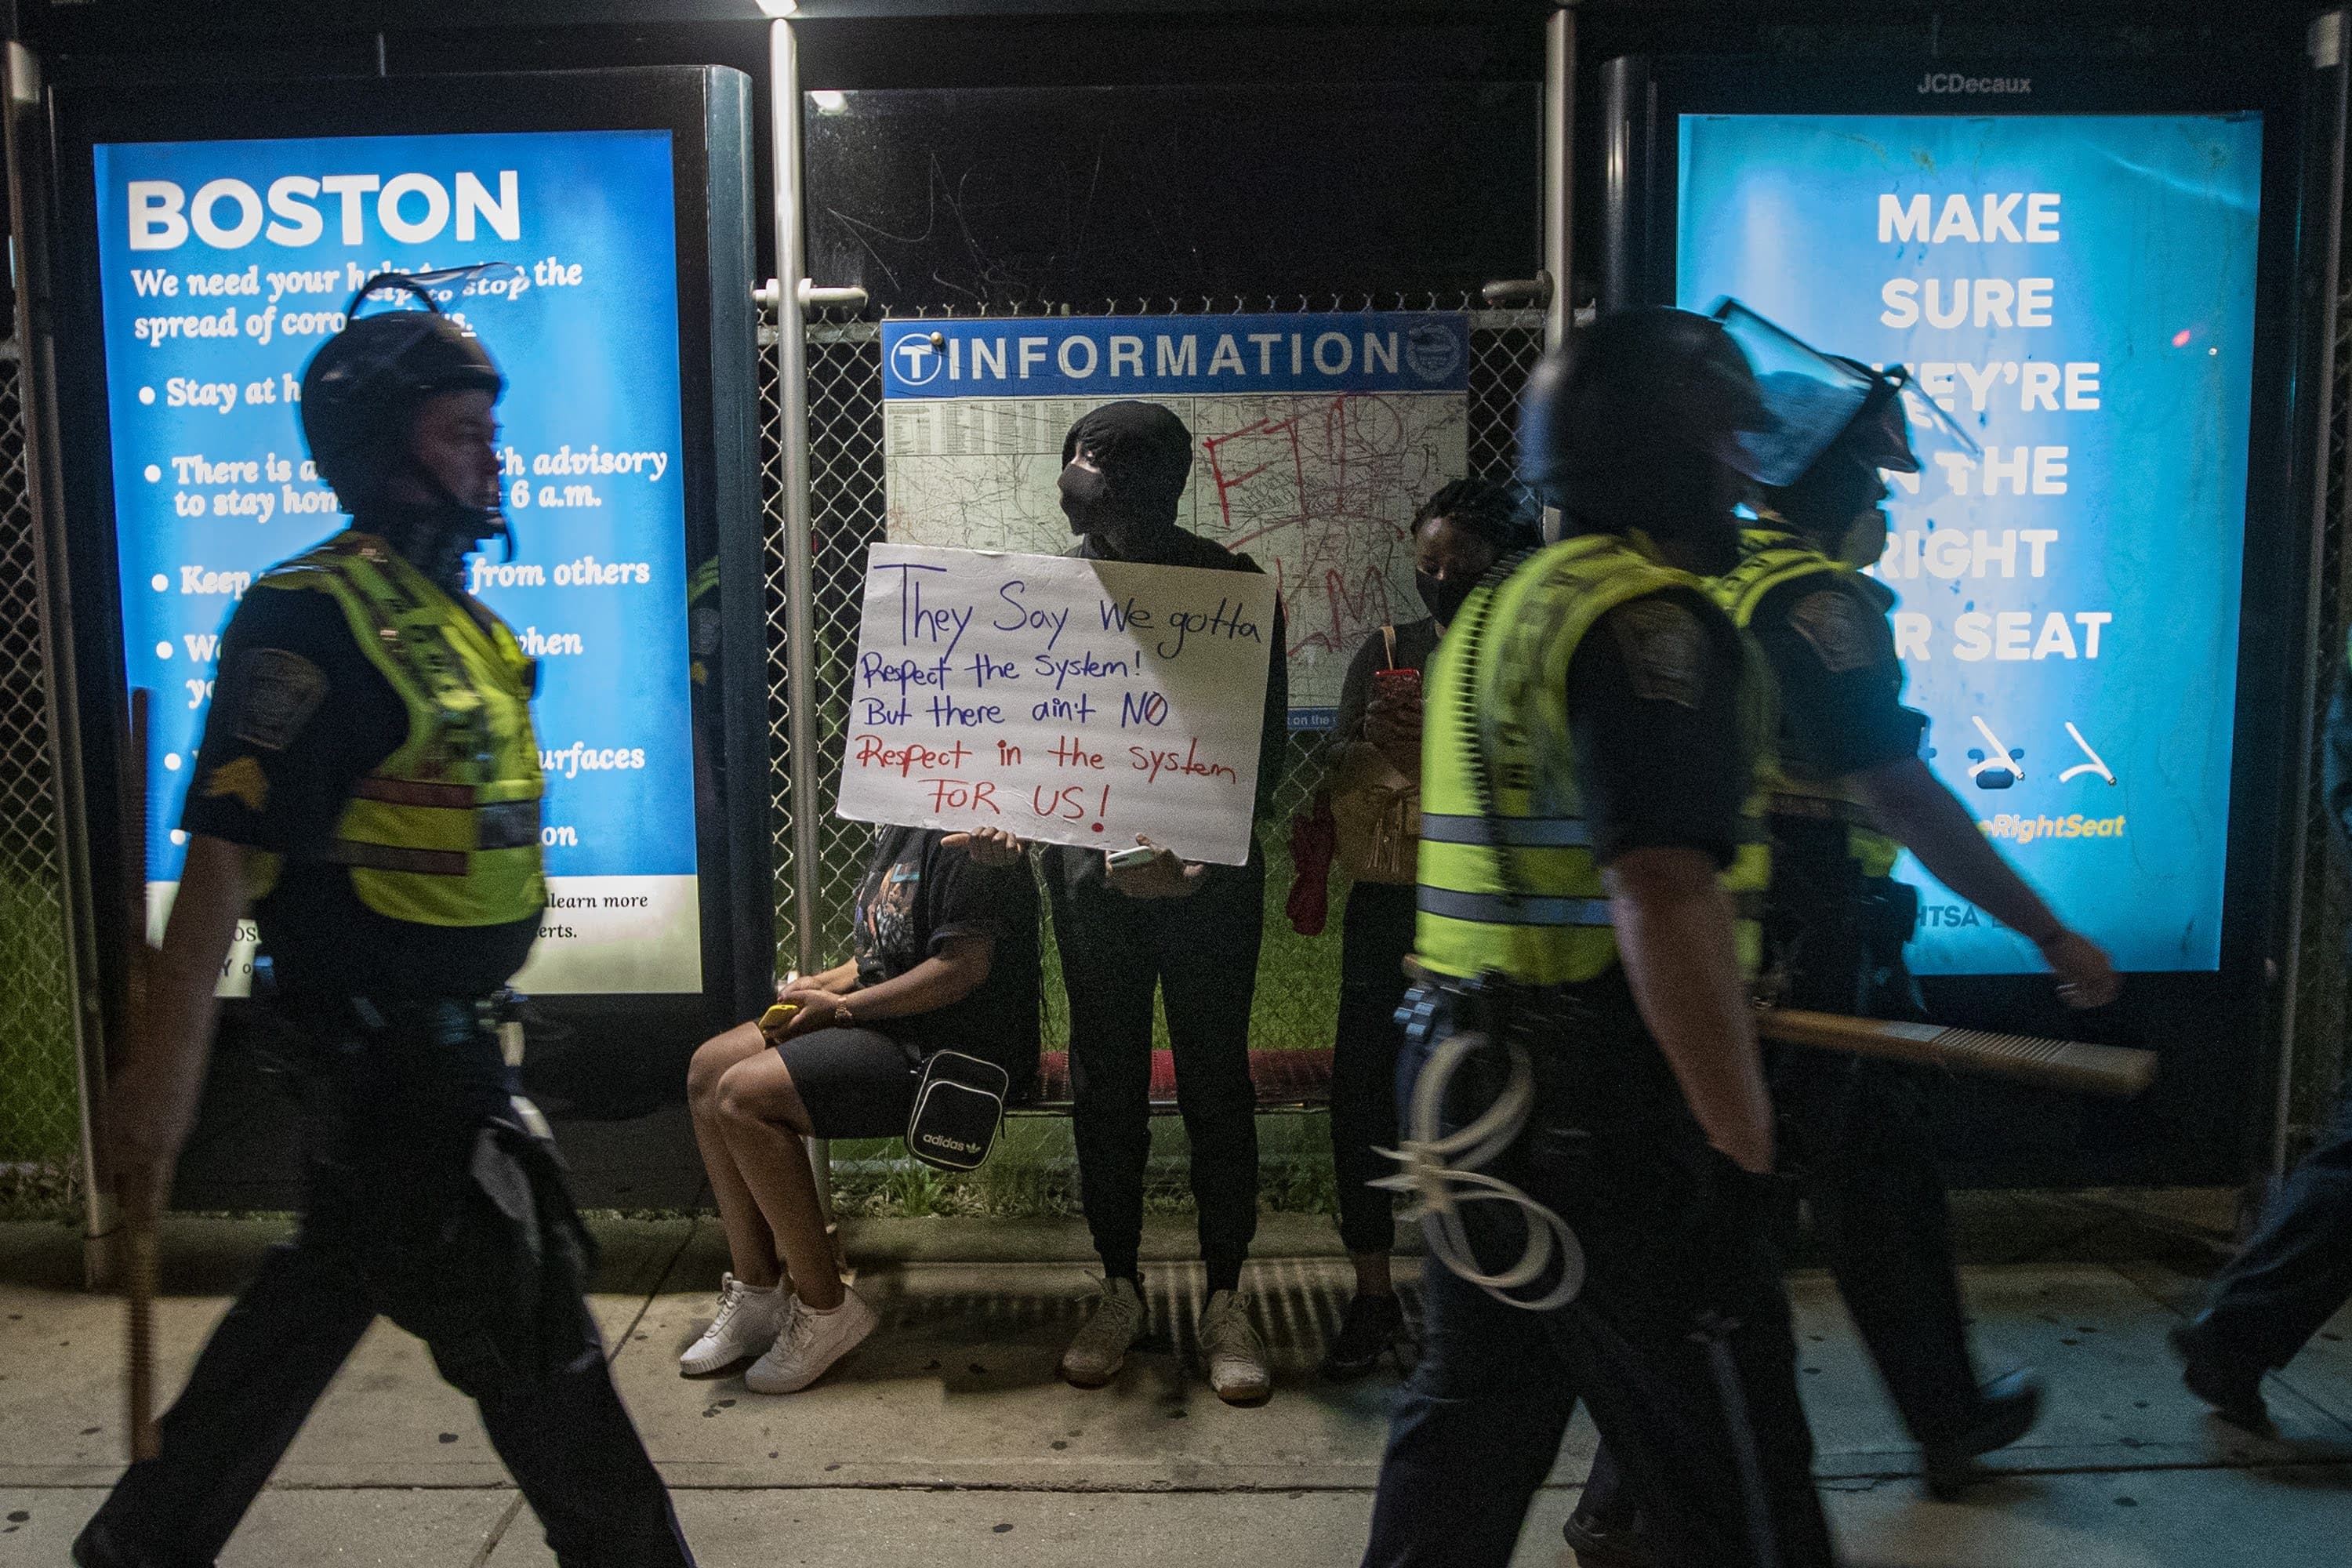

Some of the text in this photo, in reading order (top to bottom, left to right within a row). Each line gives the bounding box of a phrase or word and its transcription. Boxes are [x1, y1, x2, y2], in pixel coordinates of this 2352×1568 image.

[1918, 74, 2031, 93] JCDecaux
[129, 170, 521, 250] BOSTON
[1878, 193, 2061, 243] MAKE
[131, 269, 179, 297] We
[187, 264, 260, 296] need
[267, 270, 340, 303] your
[534, 256, 583, 287] the
[1880, 278, 2054, 329] SURE
[135, 307, 238, 347] spread
[245, 306, 277, 346] of
[949, 330, 1398, 380] INFORMATION
[166, 377, 237, 414] Stay
[245, 377, 276, 404] at
[172, 454, 259, 485] There
[265, 452, 292, 482] is
[533, 445, 667, 481] advisory
[1934, 446, 2069, 496] THE
[175, 490, 205, 517] to
[213, 489, 274, 524] stay
[510, 480, 530, 508] 6
[539, 484, 601, 507] a.m.
[1864, 528, 2059, 579] RIGHT
[180, 556, 651, 601] Keep from others
[873, 564, 1261, 664] They Say We gotta
[1953, 612, 2113, 662] SEAT
[860, 652, 953, 696] Respect
[964, 653, 1020, 688] the
[858, 698, 913, 726] But
[926, 695, 1005, 728] there
[538, 741, 646, 779] urfaces
[855, 734, 973, 778] Respect
[996, 739, 1021, 767] in
[1047, 735, 1105, 769] the
[550, 893, 648, 909] learn more
[1915, 904, 1980, 928] HTSA
[923, 1134, 965, 1152] adidas
